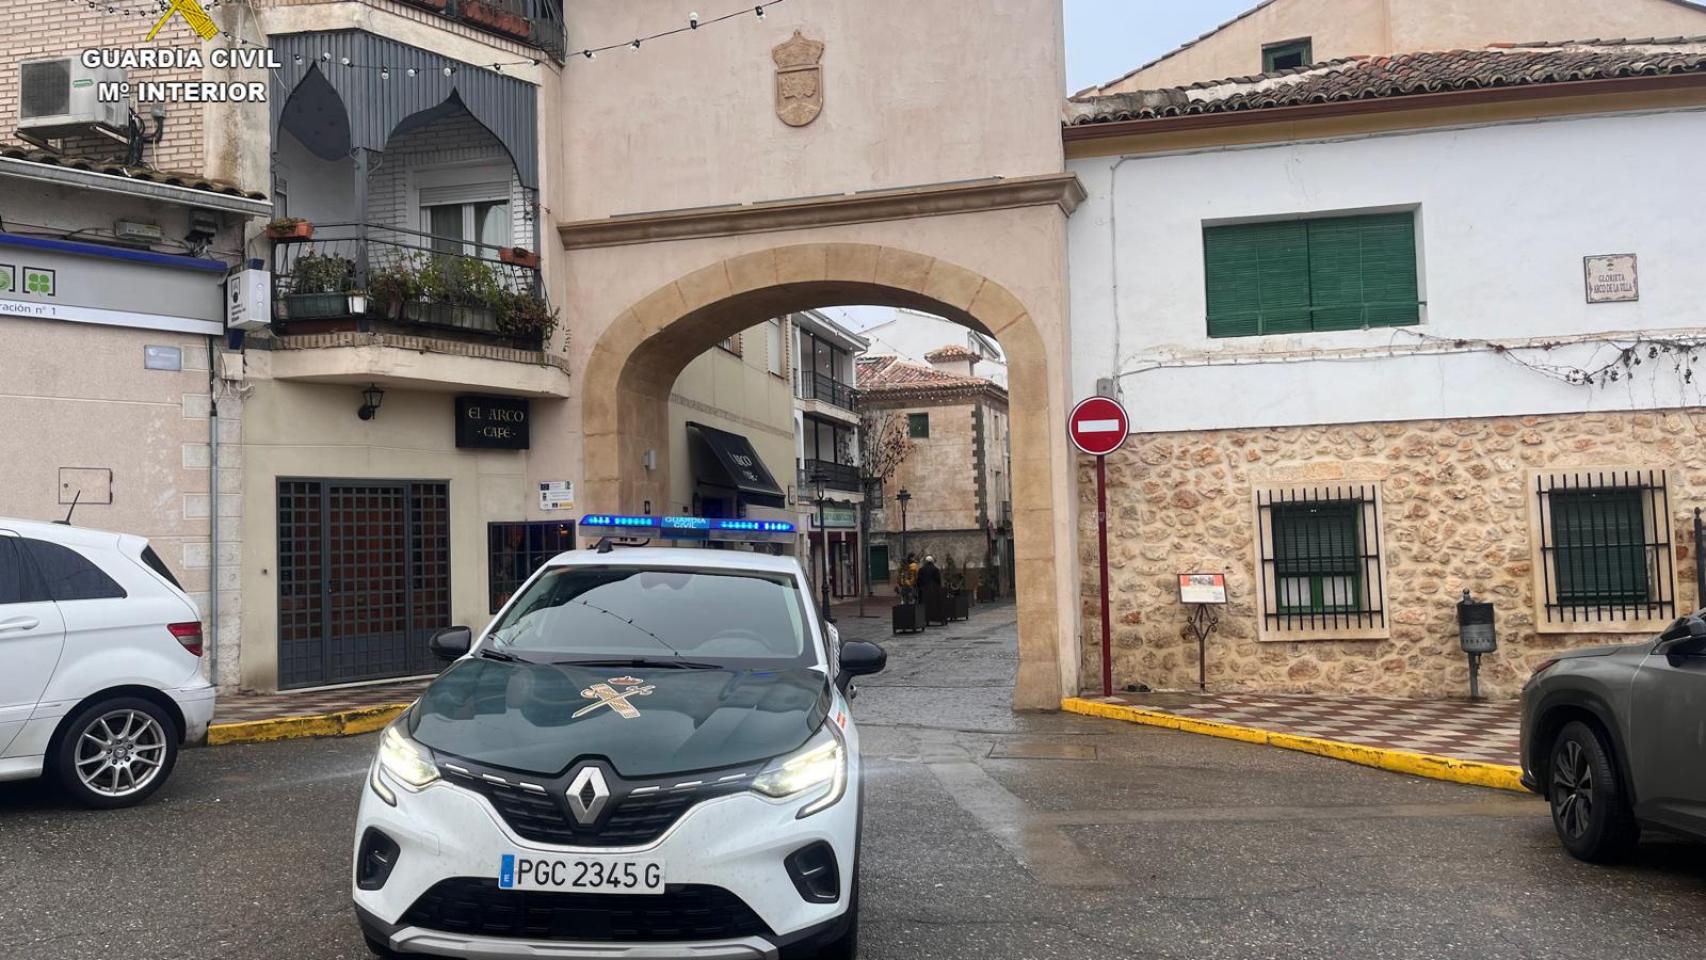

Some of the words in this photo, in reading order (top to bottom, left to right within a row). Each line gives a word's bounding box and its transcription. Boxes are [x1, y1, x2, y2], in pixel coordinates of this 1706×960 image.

[1599, 274, 1625, 282] GLORIETA
[1594, 285, 1606, 293] ARCO
[1607, 284, 1613, 292] DE
[51, 307, 56, 315] 1
[488, 409, 524, 422] ARCO
[664, 516, 706, 524] GUARDIA
[517, 859, 566, 886] PGC
[572, 861, 638, 888] 2345
[644, 863, 661, 888] G
